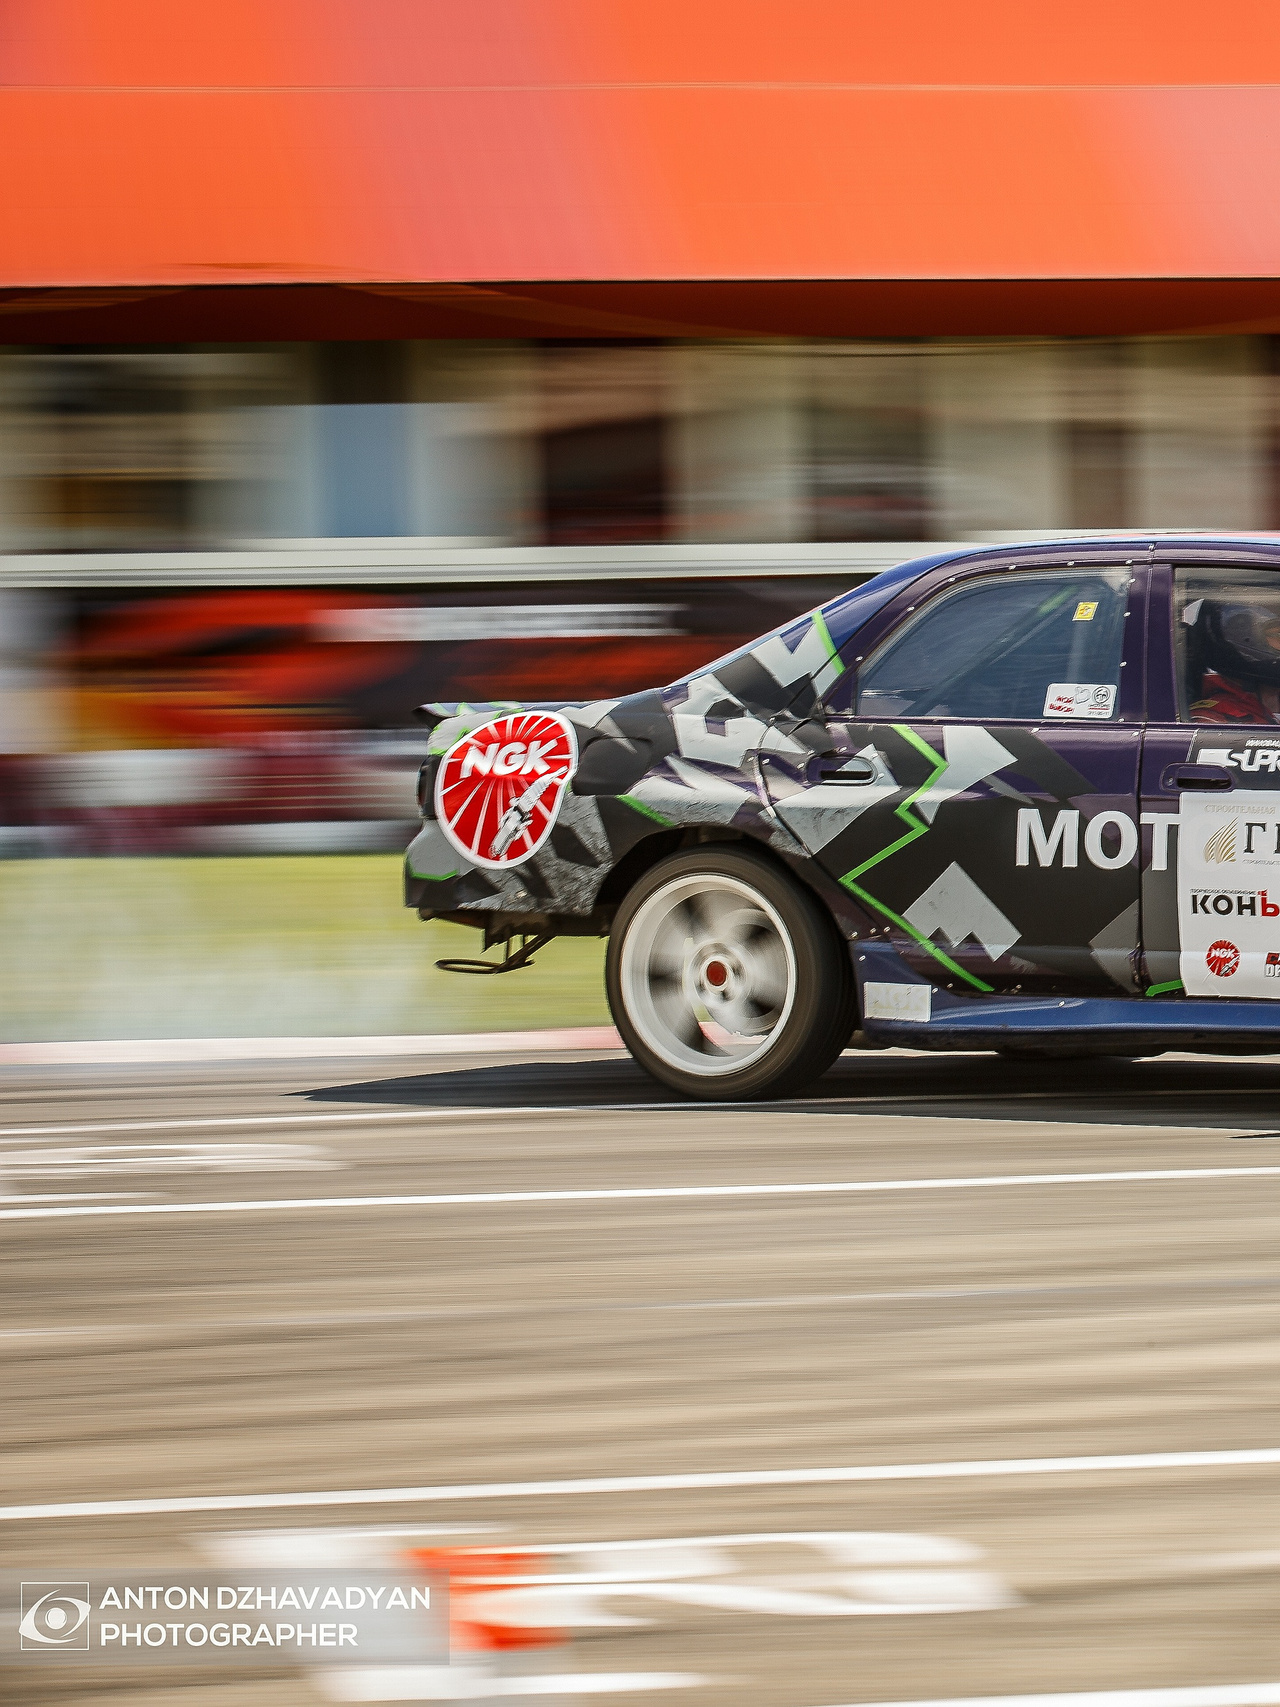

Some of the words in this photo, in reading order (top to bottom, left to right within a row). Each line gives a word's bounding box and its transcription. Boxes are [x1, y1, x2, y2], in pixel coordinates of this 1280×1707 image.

[459, 738, 560, 780] NGK
[1204, 804, 1277, 815] СТРОИТЕЛЬНАЯ
[1211, 948, 1236, 958] NGK
